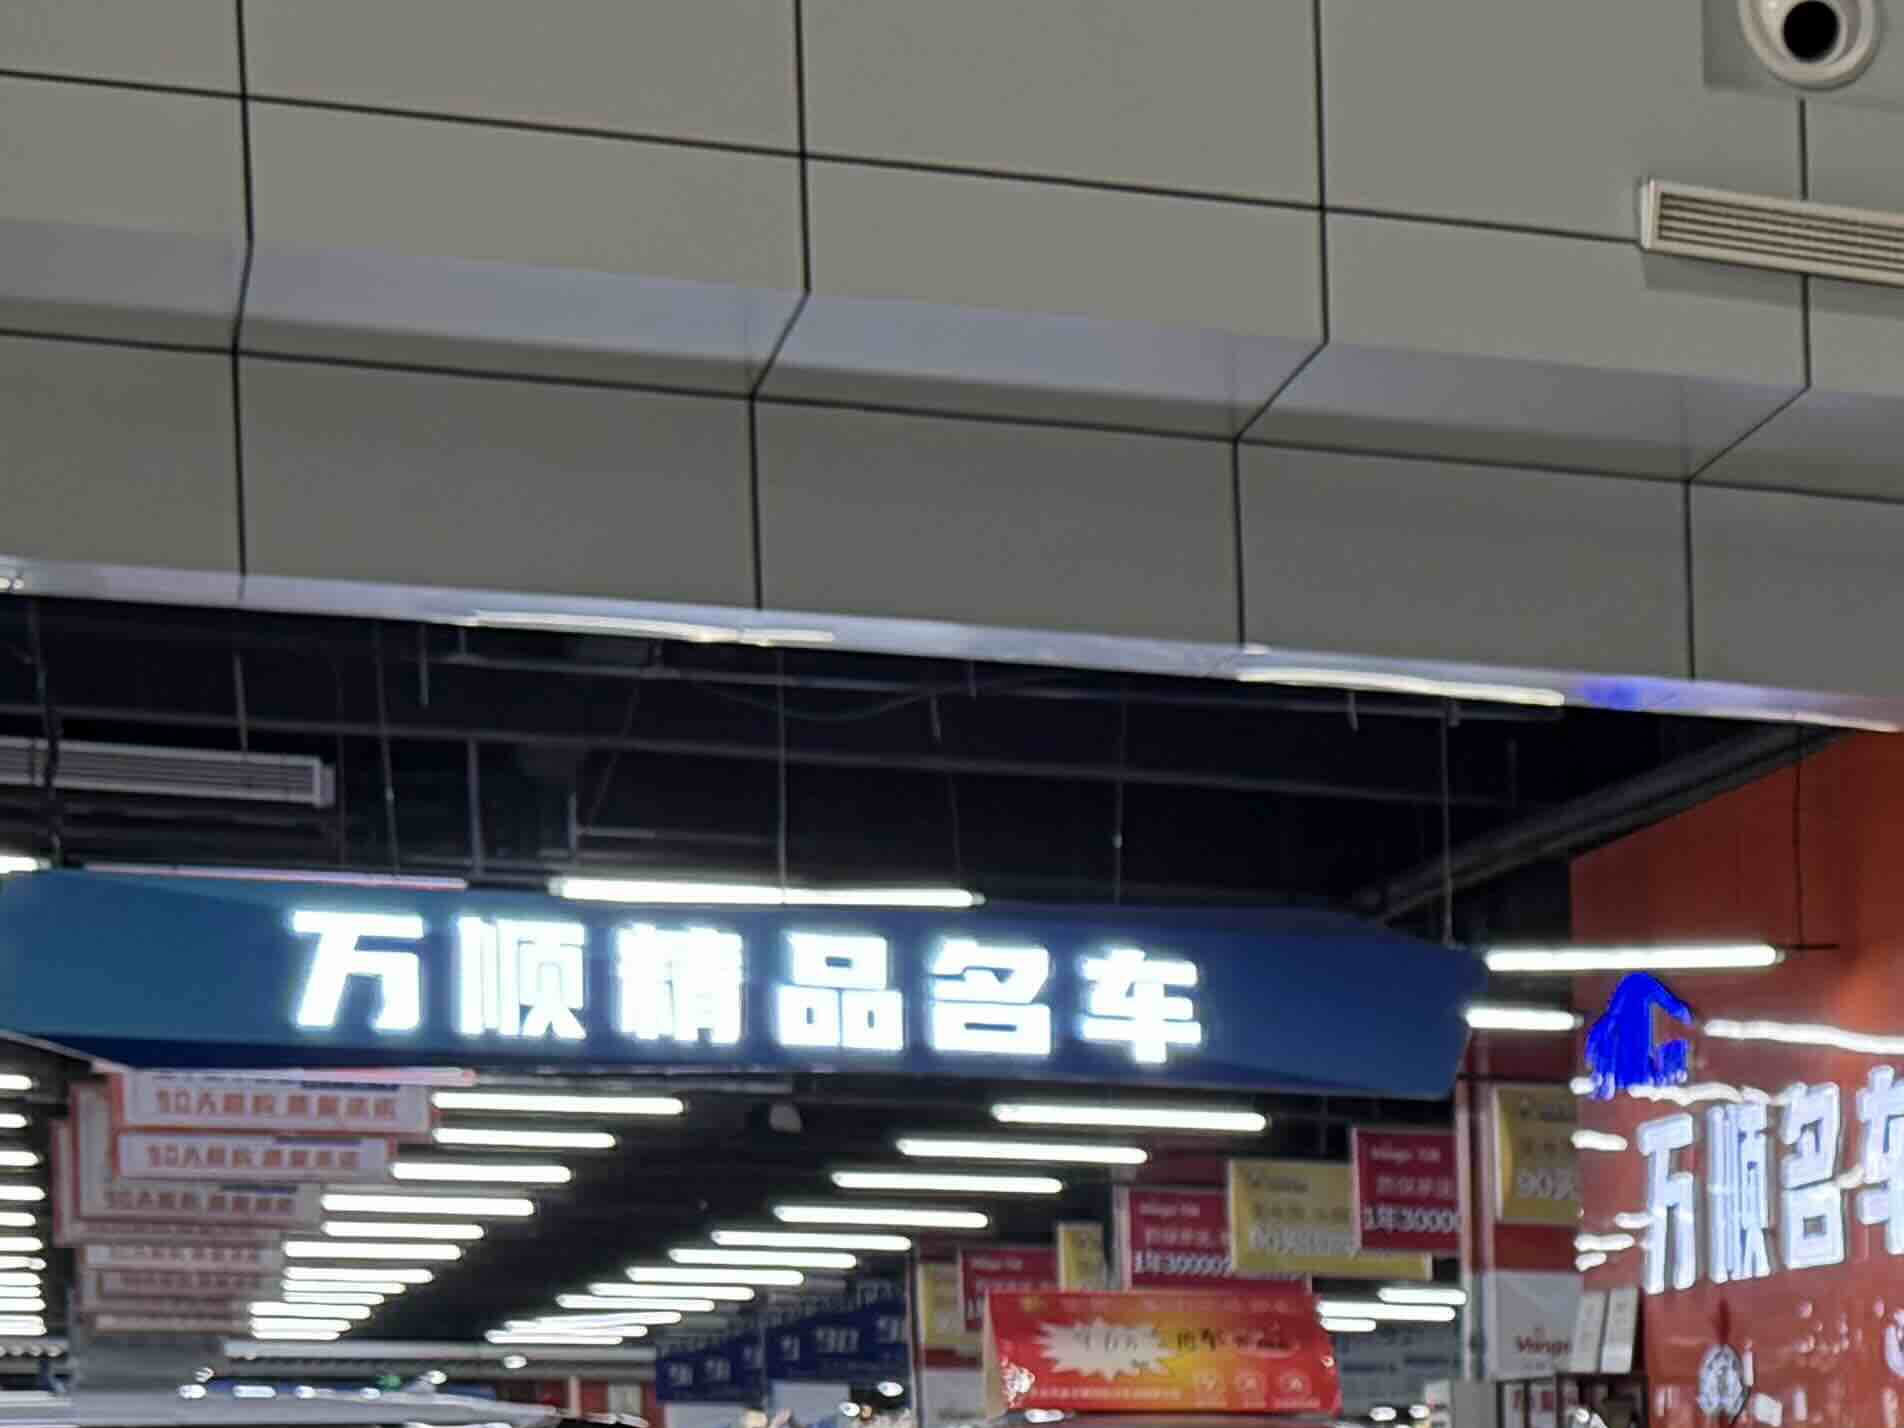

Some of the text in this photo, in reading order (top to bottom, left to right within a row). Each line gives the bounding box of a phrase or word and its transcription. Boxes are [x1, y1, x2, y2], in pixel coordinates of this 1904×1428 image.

[290, 907, 1203, 1066] 万顺精品名车
